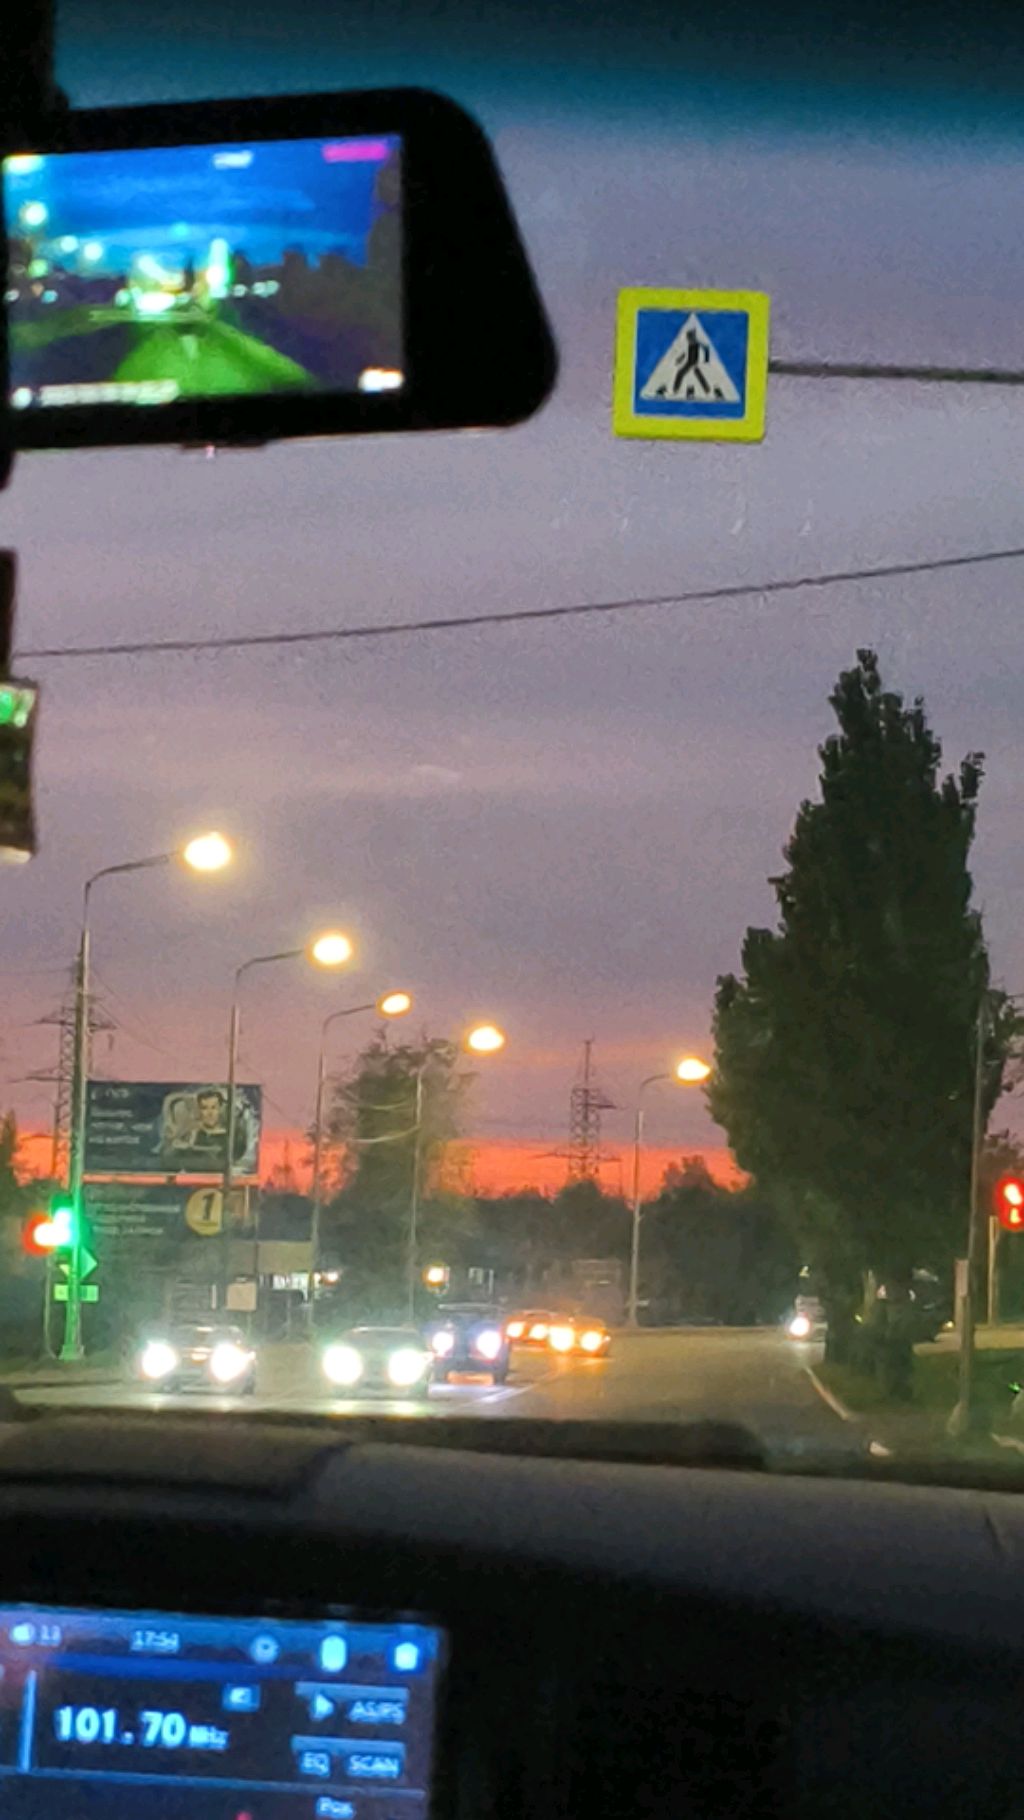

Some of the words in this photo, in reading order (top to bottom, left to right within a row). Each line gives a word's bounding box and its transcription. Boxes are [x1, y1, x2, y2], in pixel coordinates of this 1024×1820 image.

[202, 1192, 216, 1222] 1
[56, 1706, 187, 1748] 101.70
[301, 1752, 330, 1776] EQ
[348, 1754, 401, 1778] SCAN
